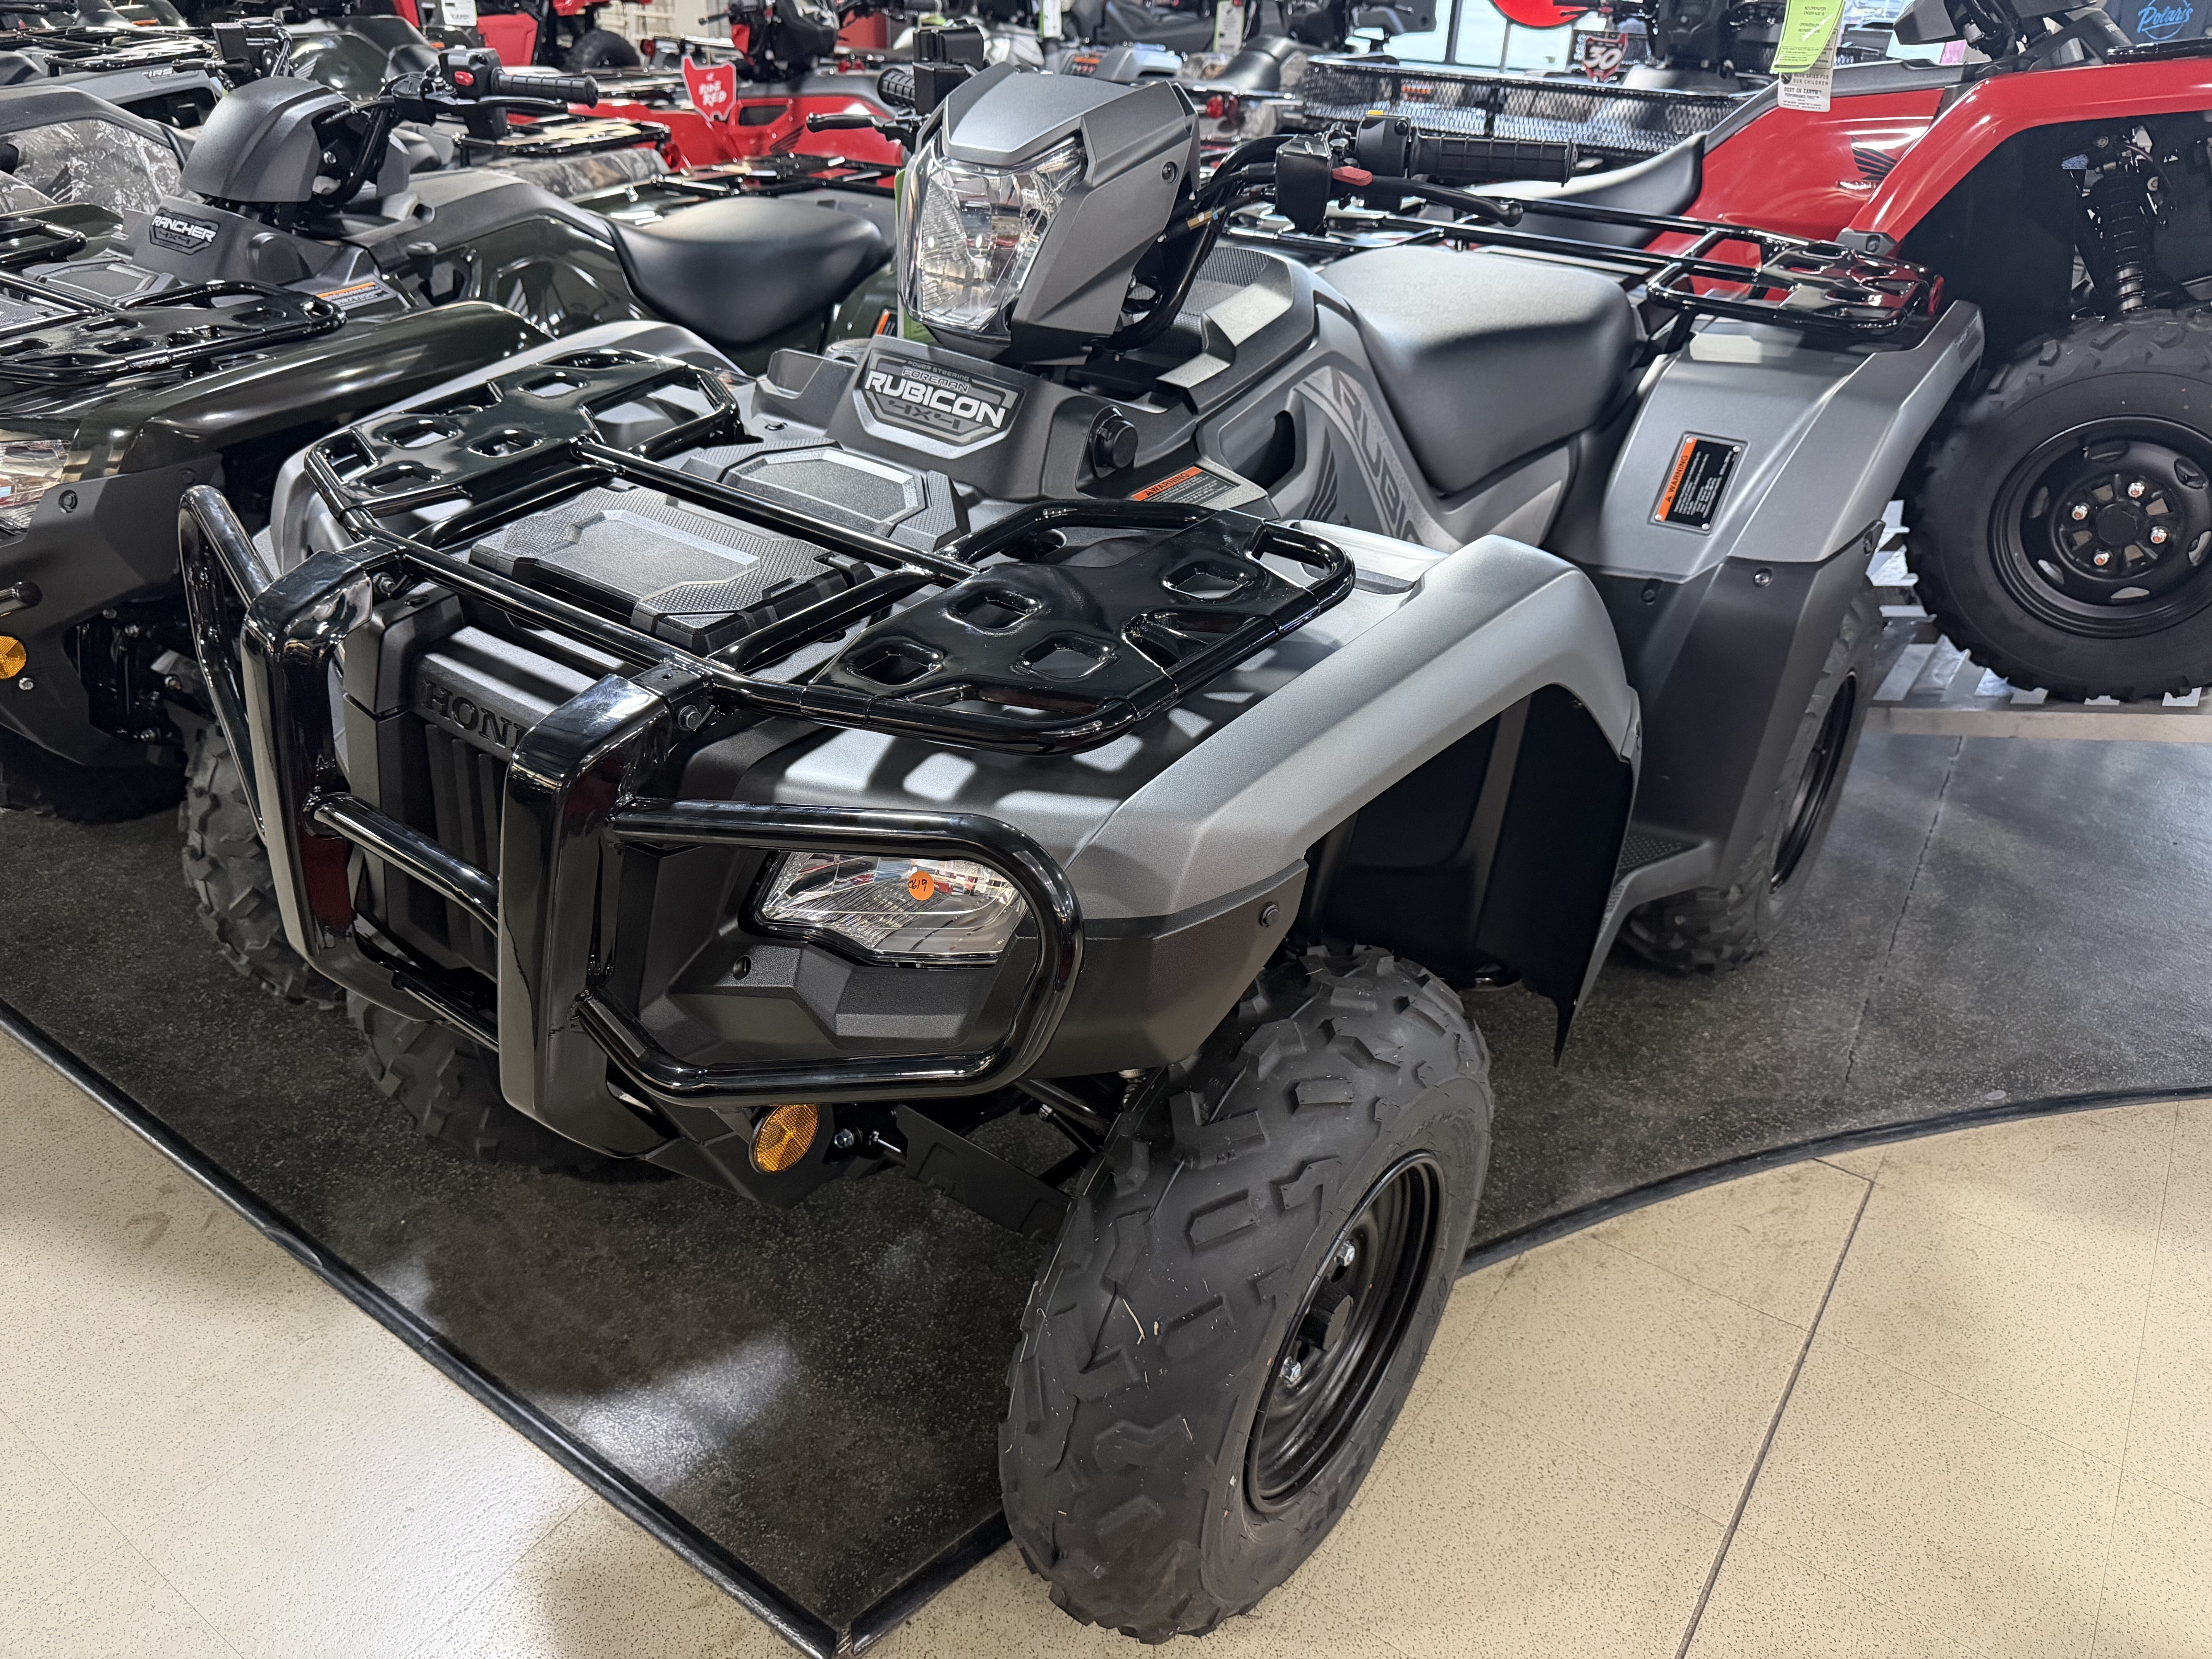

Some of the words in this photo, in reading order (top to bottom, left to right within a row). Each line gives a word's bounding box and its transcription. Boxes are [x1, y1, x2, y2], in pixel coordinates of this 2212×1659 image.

[2137, 6, 2193, 33] Polaris
[1584, 46, 1623, 70] 30
[699, 80, 721, 95] RIDE
[702, 90, 727, 107] RED
[151, 215, 216, 242] RANCHER
[902, 368, 969, 393] FOREMAN
[908, 361, 932, 371] POWER
[932, 367, 970, 381] STEERING
[865, 370, 1006, 428] RUBICON
[1148, 472, 1190, 494] WARNING
[1668, 455, 1688, 492] WARNING
[422, 678, 529, 752] HON
